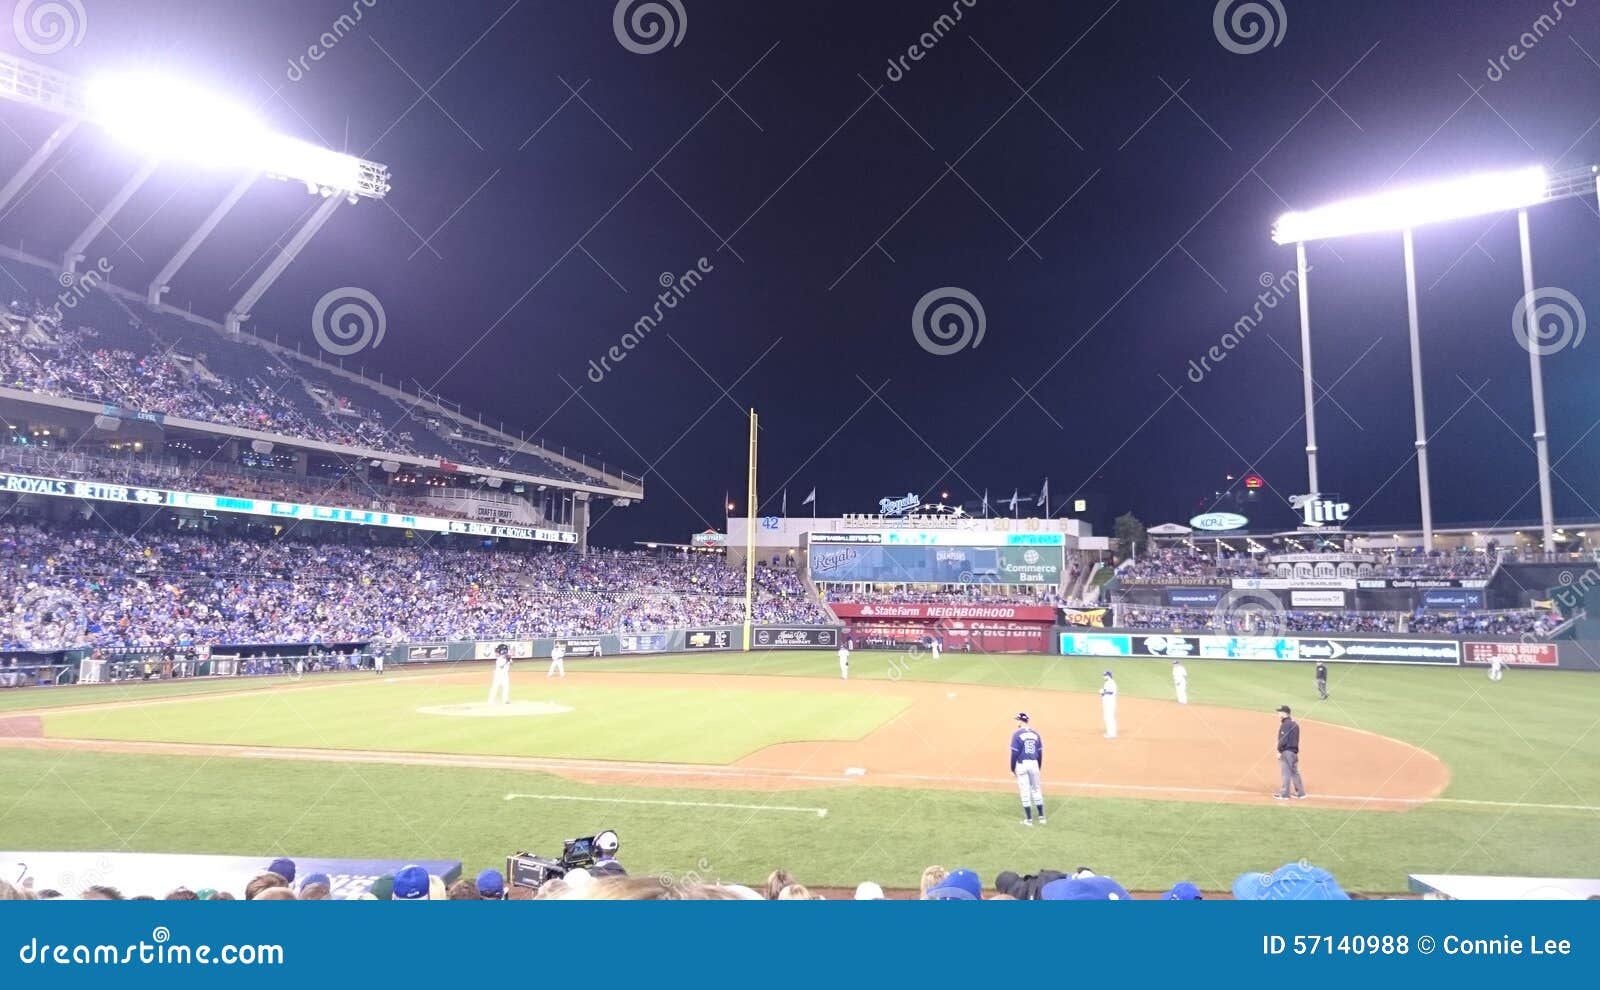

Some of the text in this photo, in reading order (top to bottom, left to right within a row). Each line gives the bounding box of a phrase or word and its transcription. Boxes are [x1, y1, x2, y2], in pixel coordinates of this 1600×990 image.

[7, 475, 66, 495] ROYALS
[74, 482, 128, 501] BETTER
[879, 493, 920, 516] Royals
[1302, 500, 1350, 527] Lite
[762, 517, 779, 529] 42
[993, 517, 1010, 530] 20
[1025, 517, 1040, 530] 10
[814, 547, 857, 572] Royals
[1006, 564, 1057, 573] Commerce
[1020, 573, 1045, 582] Bank
[926, 606, 1015, 618] NEIGHBORHOOD
[1067, 613, 1103, 624] SONIC
